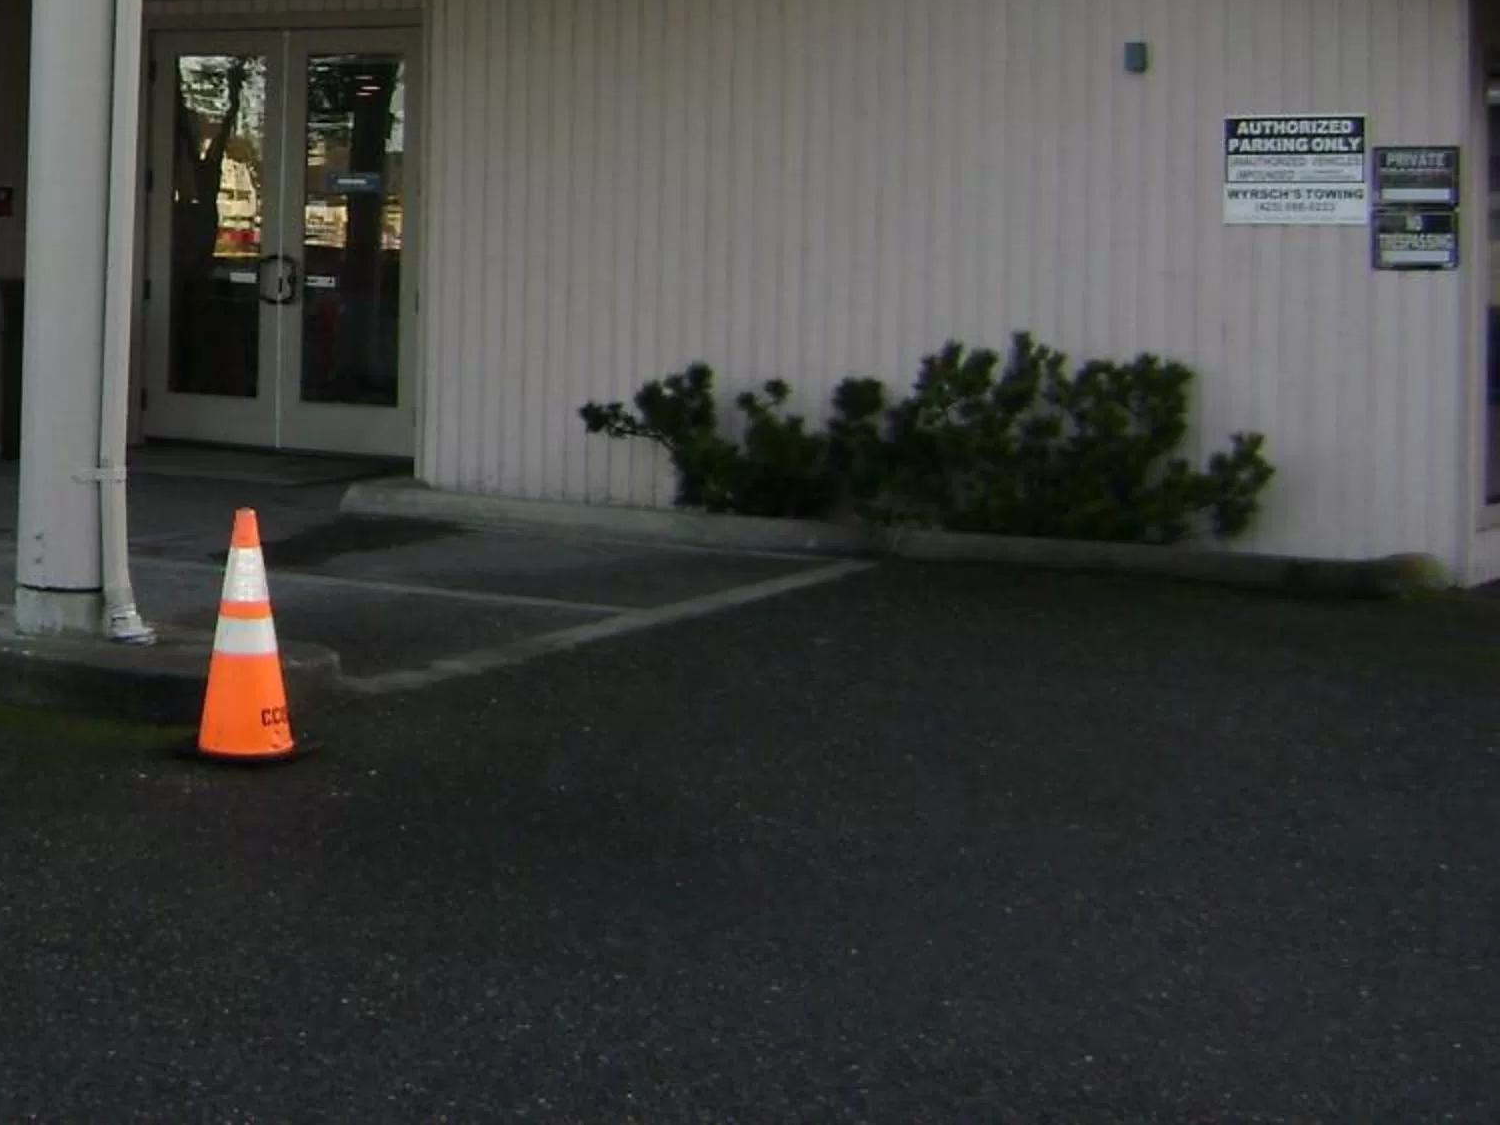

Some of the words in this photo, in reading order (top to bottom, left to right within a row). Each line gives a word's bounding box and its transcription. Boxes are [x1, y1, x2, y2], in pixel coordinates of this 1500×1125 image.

[1236, 120, 1353, 135] AUTHORIZED
[1227, 137, 1308, 152] PARKING
[1311, 136, 1362, 151] ONLY
[1306, 188, 1364, 200] TOWING
